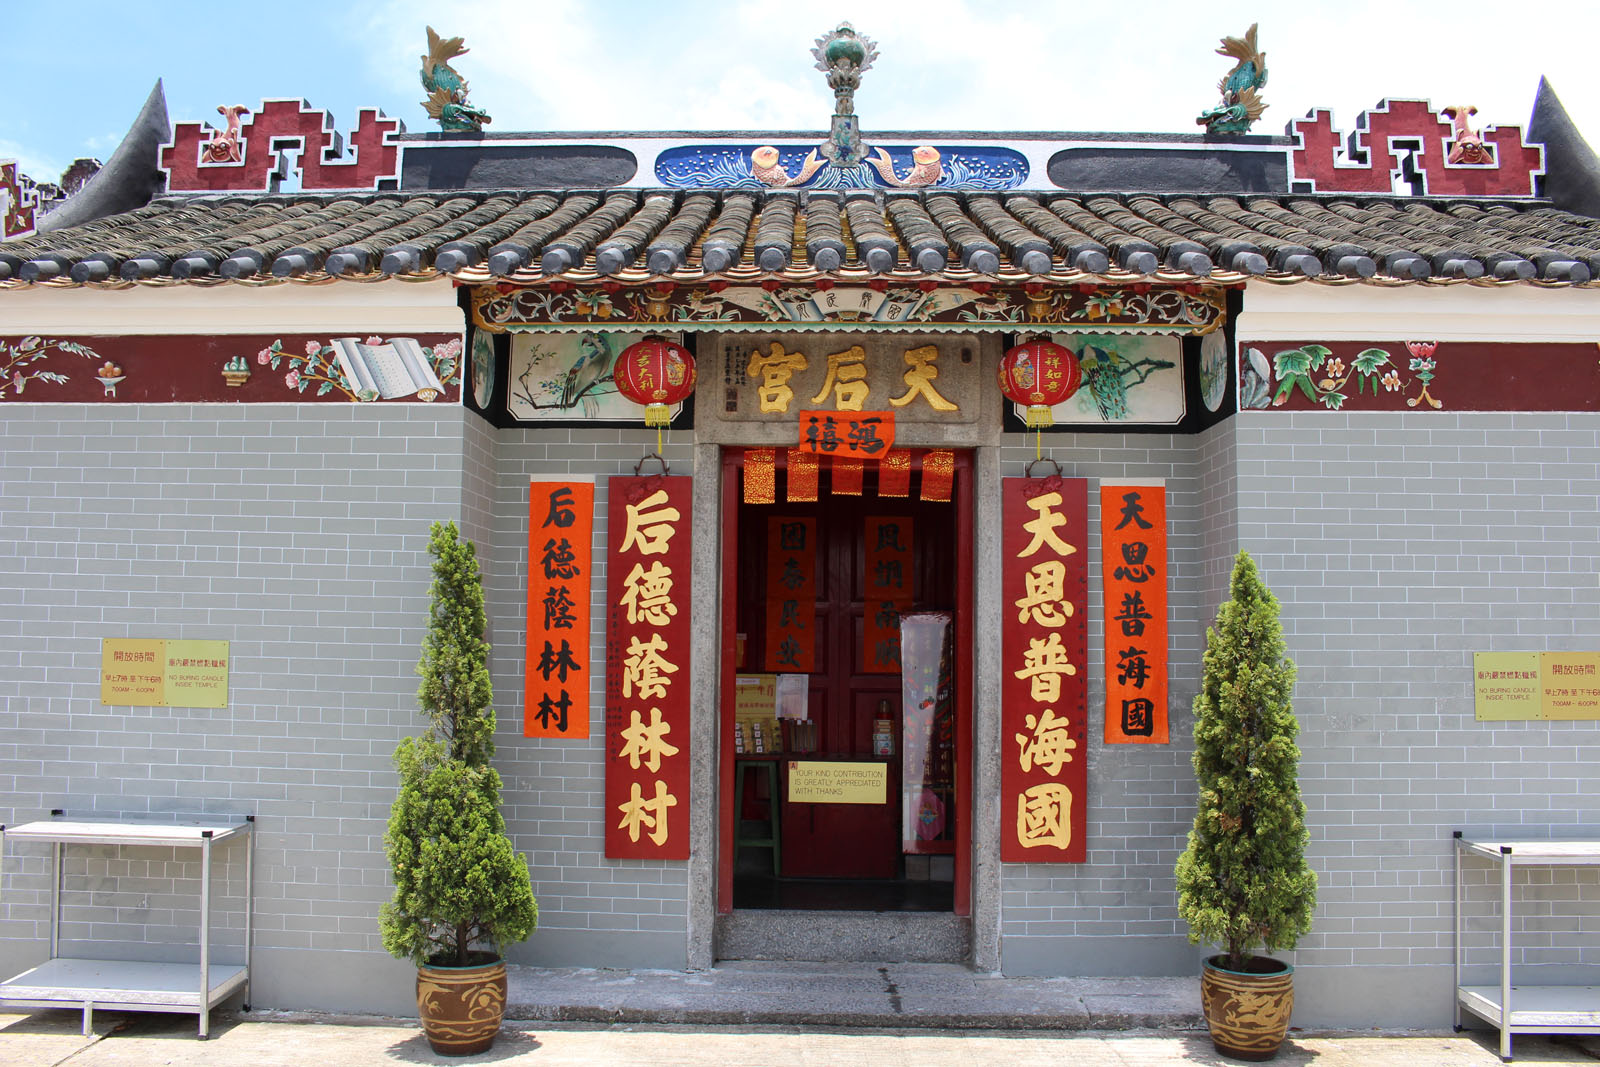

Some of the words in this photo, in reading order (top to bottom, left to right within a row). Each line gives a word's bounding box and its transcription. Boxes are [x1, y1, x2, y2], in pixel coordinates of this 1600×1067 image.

[636, 346, 654, 392] 大吉大利
[747, 341, 960, 414] 天后宮
[1044, 346, 1063, 393] 吉祥如意
[534, 487, 581, 733] 后德蔭林村
[775, 522, 809, 668] 國泰民安
[873, 523, 907, 667] 風調雨順
[1113, 492, 1155, 738] 天恩普海國
[113, 650, 155, 662] 開放時間
[618, 489, 681, 847] 后德蔭林村
[1014, 492, 1077, 850] 天恩普海國
[1552, 664, 1596, 675] 開放時間
[794, 778, 802, 786] IS
[804, 778, 833, 786] GREATLY
[836, 779, 881, 787] APPRECIATED
[795, 769, 813, 777] YOUR
[833, 770, 883, 778] CONTRIBUTION
[795, 787, 813, 795] WITH
[816, 787, 843, 796] THANKS
